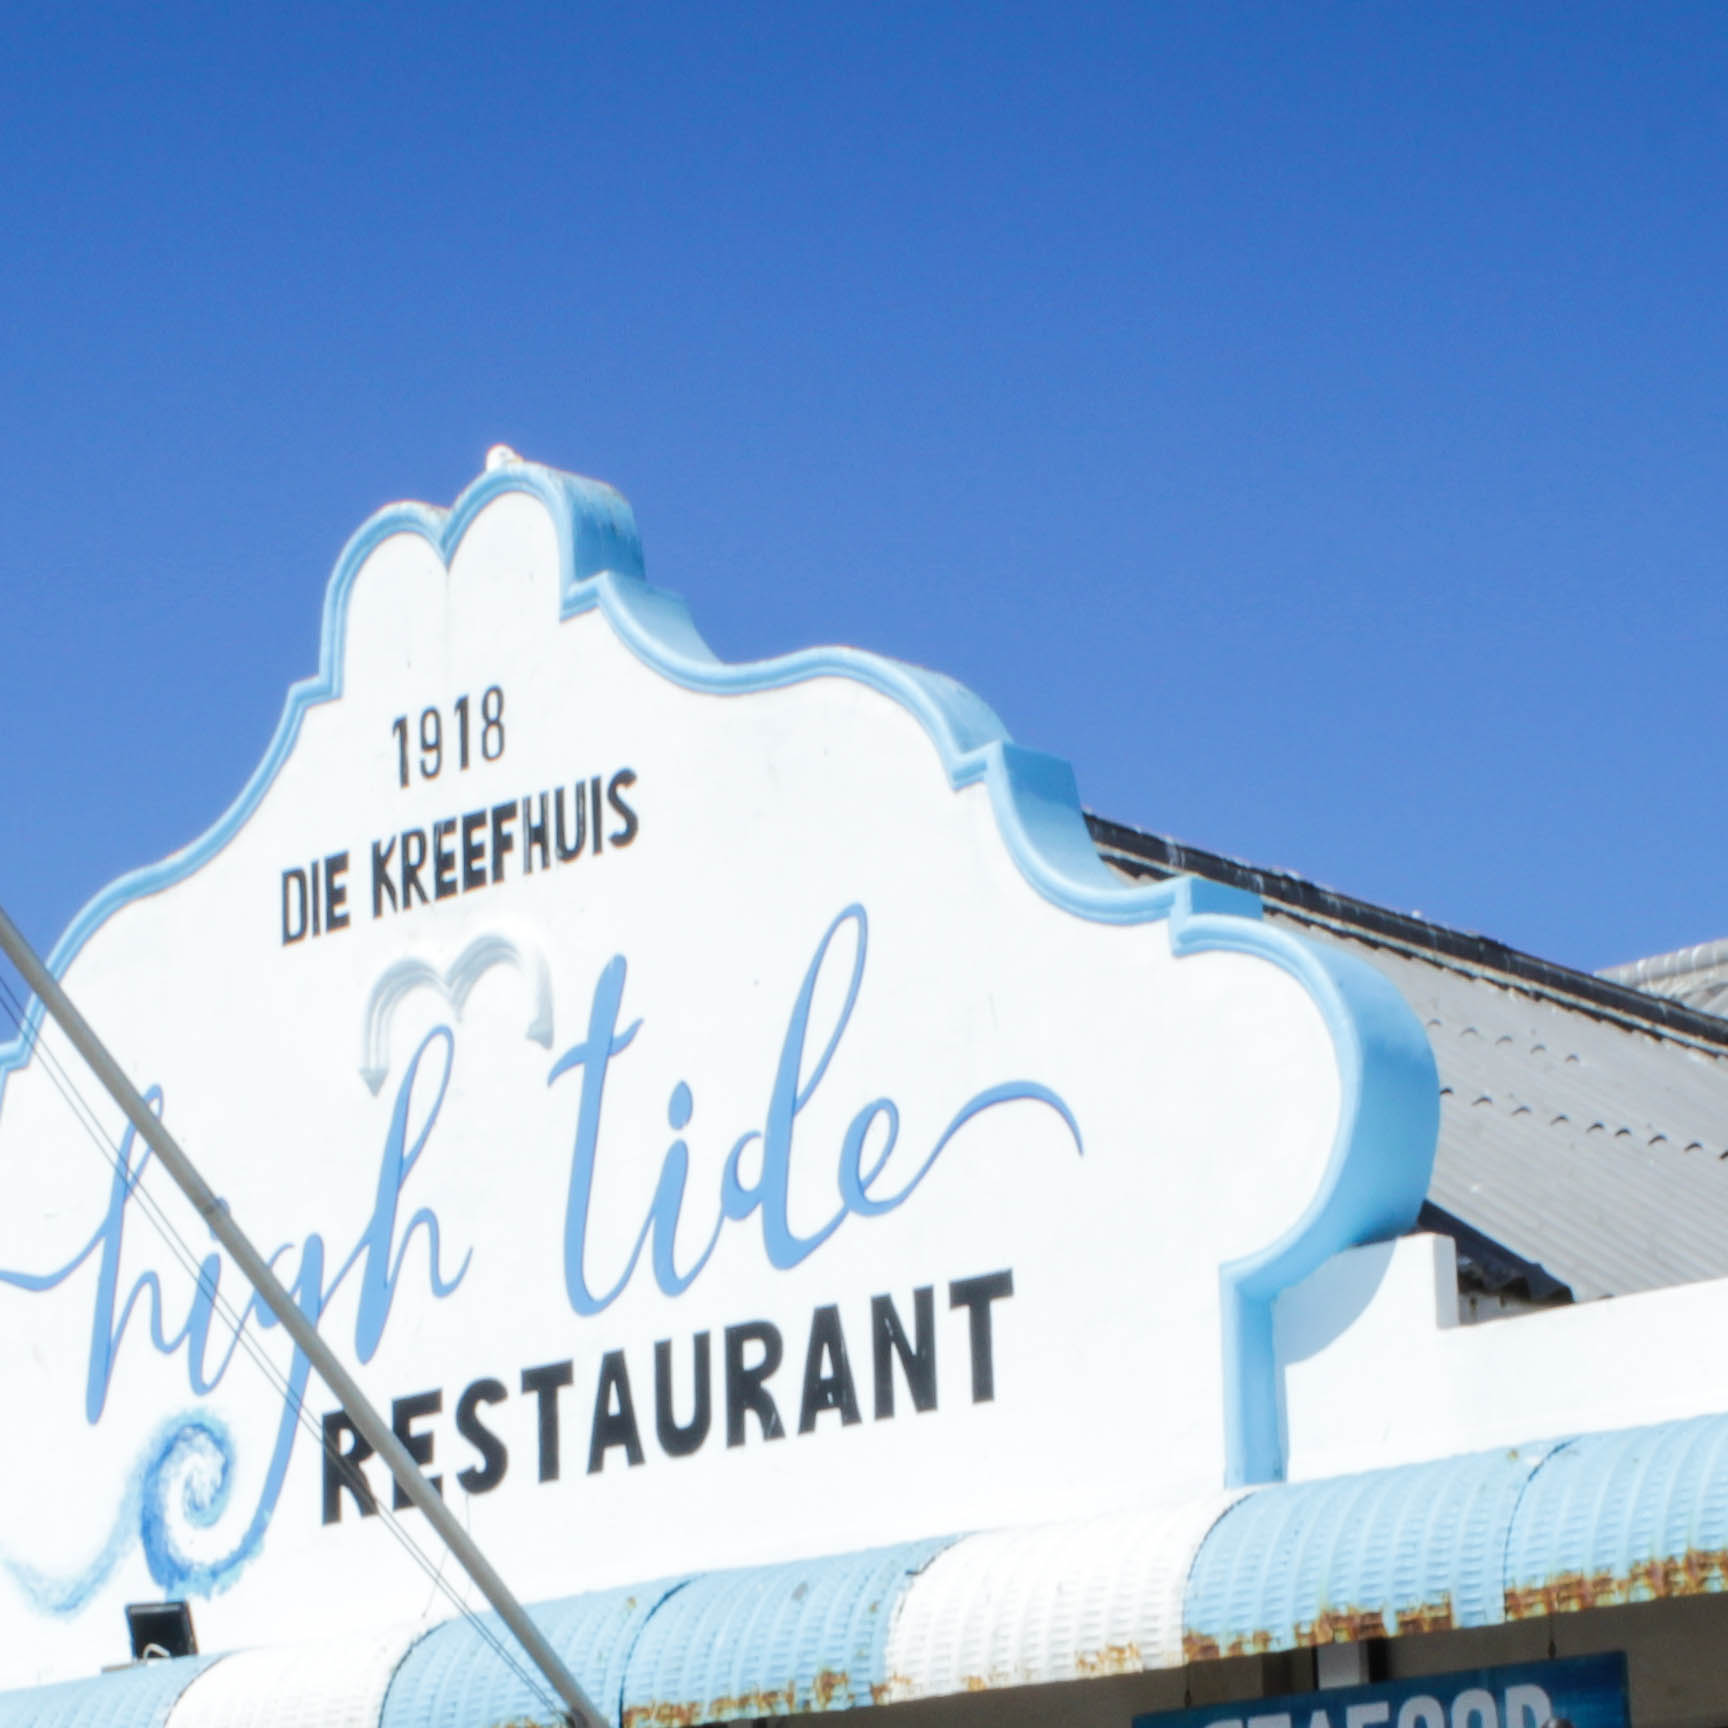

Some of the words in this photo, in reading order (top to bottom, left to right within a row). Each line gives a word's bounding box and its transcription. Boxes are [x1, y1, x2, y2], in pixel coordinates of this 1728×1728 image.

[390, 684, 507, 790] 1918
[280, 850, 351, 947] DIE
[370, 767, 640, 919] KREEFHUIS
[547, 902, 1085, 1318] tide
[321, 1267, 1015, 1526] RESTAURANT
